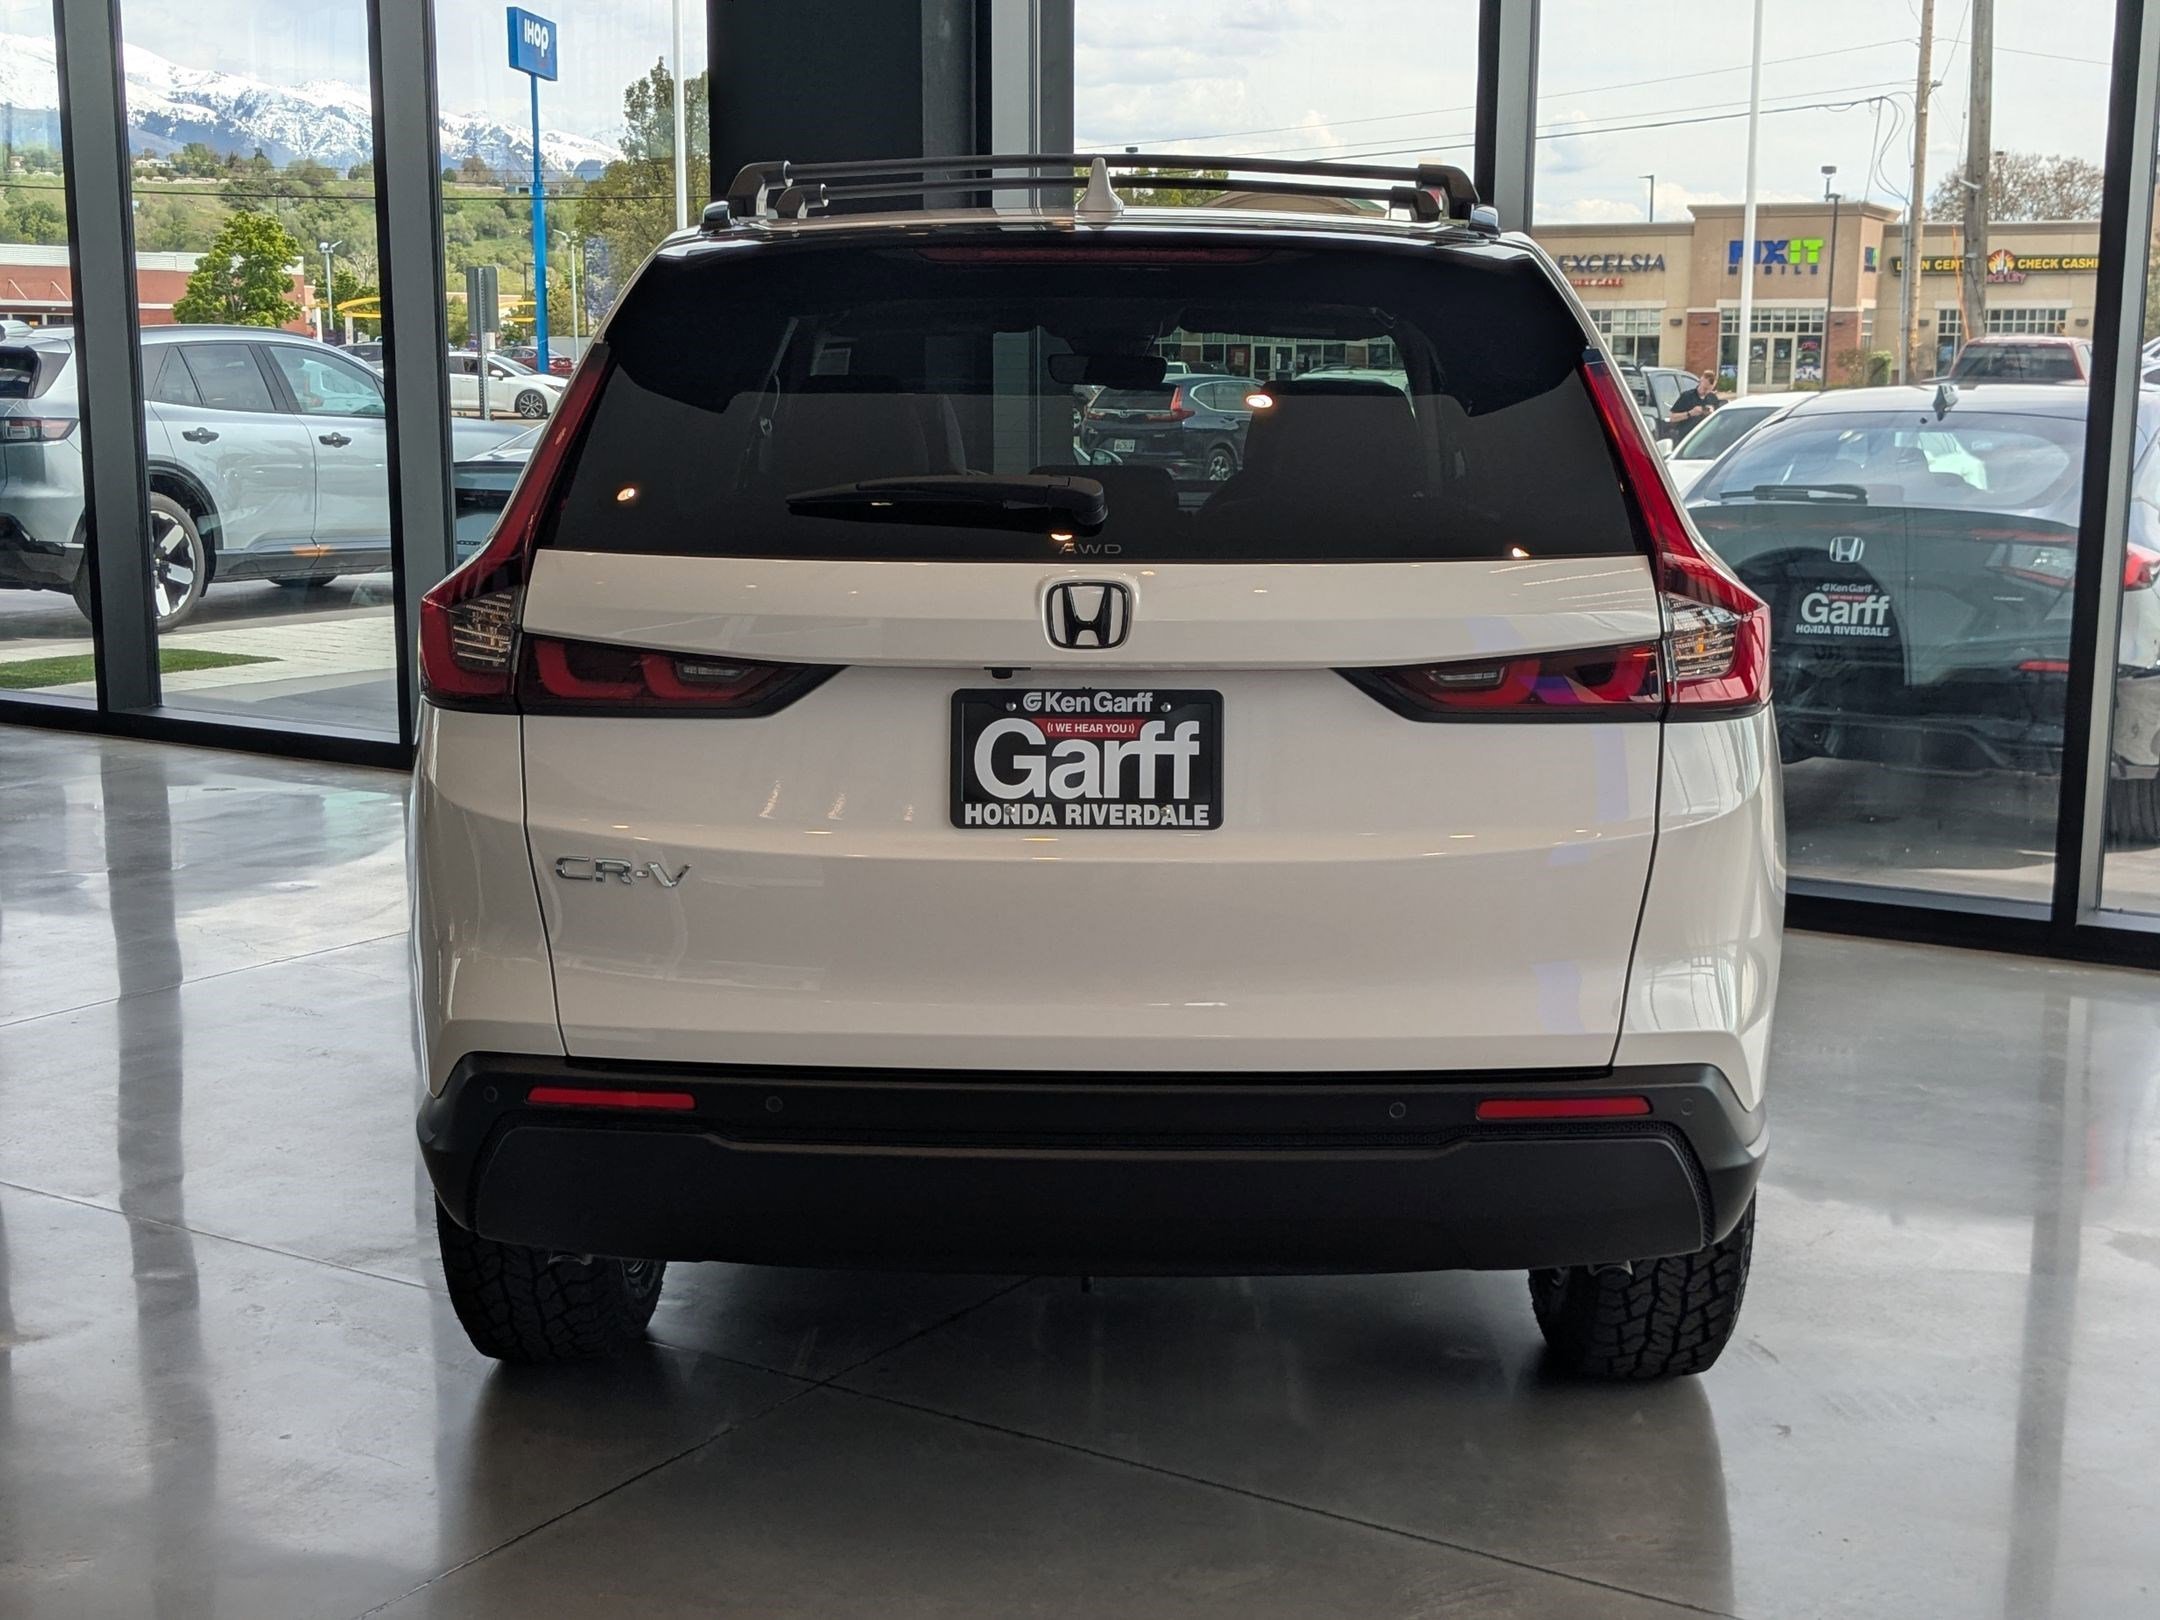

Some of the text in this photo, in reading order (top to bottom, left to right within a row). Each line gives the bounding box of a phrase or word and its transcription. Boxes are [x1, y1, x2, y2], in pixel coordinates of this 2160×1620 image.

[1728, 265, 1819, 275] MBILE
[1896, 259, 1931, 271] LN
[2017, 257, 2099, 270] CHECK CASHI
[1059, 542, 1122, 554] AWD
[1801, 592, 1890, 625] Garff
[1795, 624, 1890, 637] HONDA RIVERDALE
[1045, 691, 1153, 713] Ken Garff
[1055, 723, 1127, 734] WE HEAR YOU
[973, 717, 1200, 800] Garff
[964, 803, 1210, 827] HONDA RIVERDALE
[555, 856, 692, 888] CR-V
